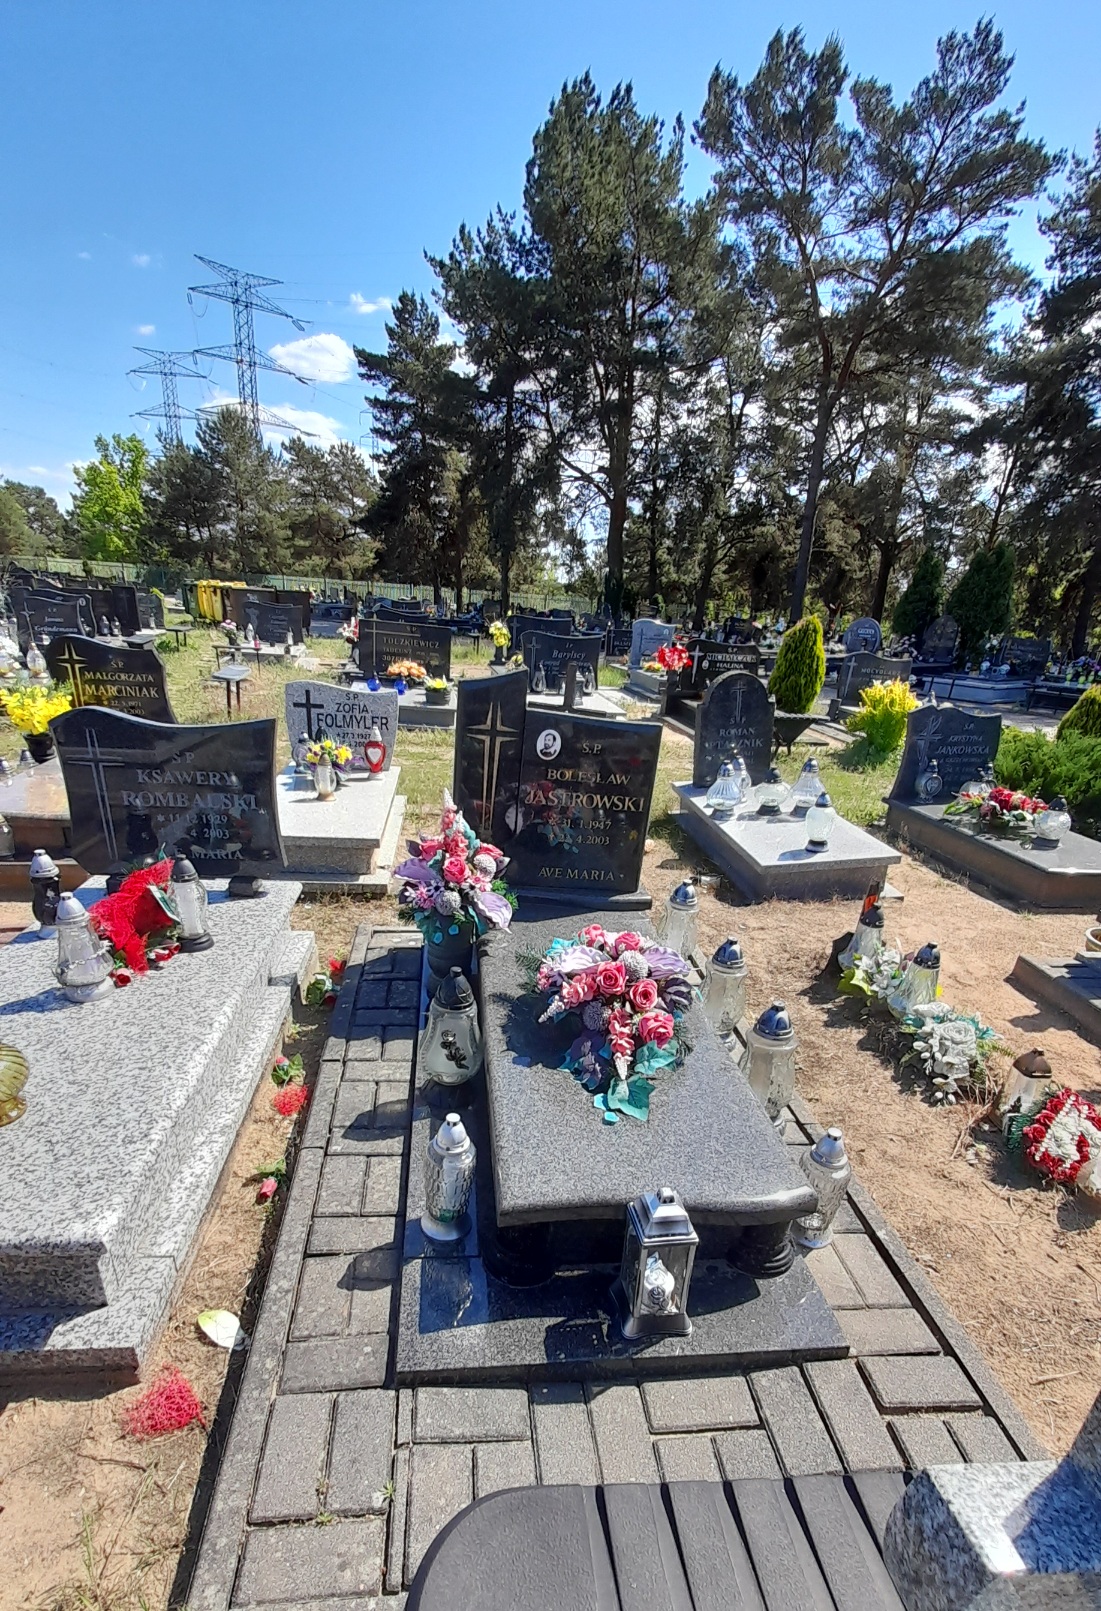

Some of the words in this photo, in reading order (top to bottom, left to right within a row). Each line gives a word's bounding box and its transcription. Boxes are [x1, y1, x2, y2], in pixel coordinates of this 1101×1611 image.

[84, 684, 159, 698] MARCINIAK
[335, 703, 370, 714] ZOFIA
[317, 713, 389, 731] FOLMYLER
[936, 746, 989, 755] JANKOWSKA
[136, 769, 236, 786] KSAWERY
[121, 791, 258, 810] ROMBALSKI
[525, 789, 646, 813] JASTROWSKI
[192, 850, 243, 859] MARIA
[539, 867, 563, 877] AVE
[566, 869, 614, 880] MARIA
